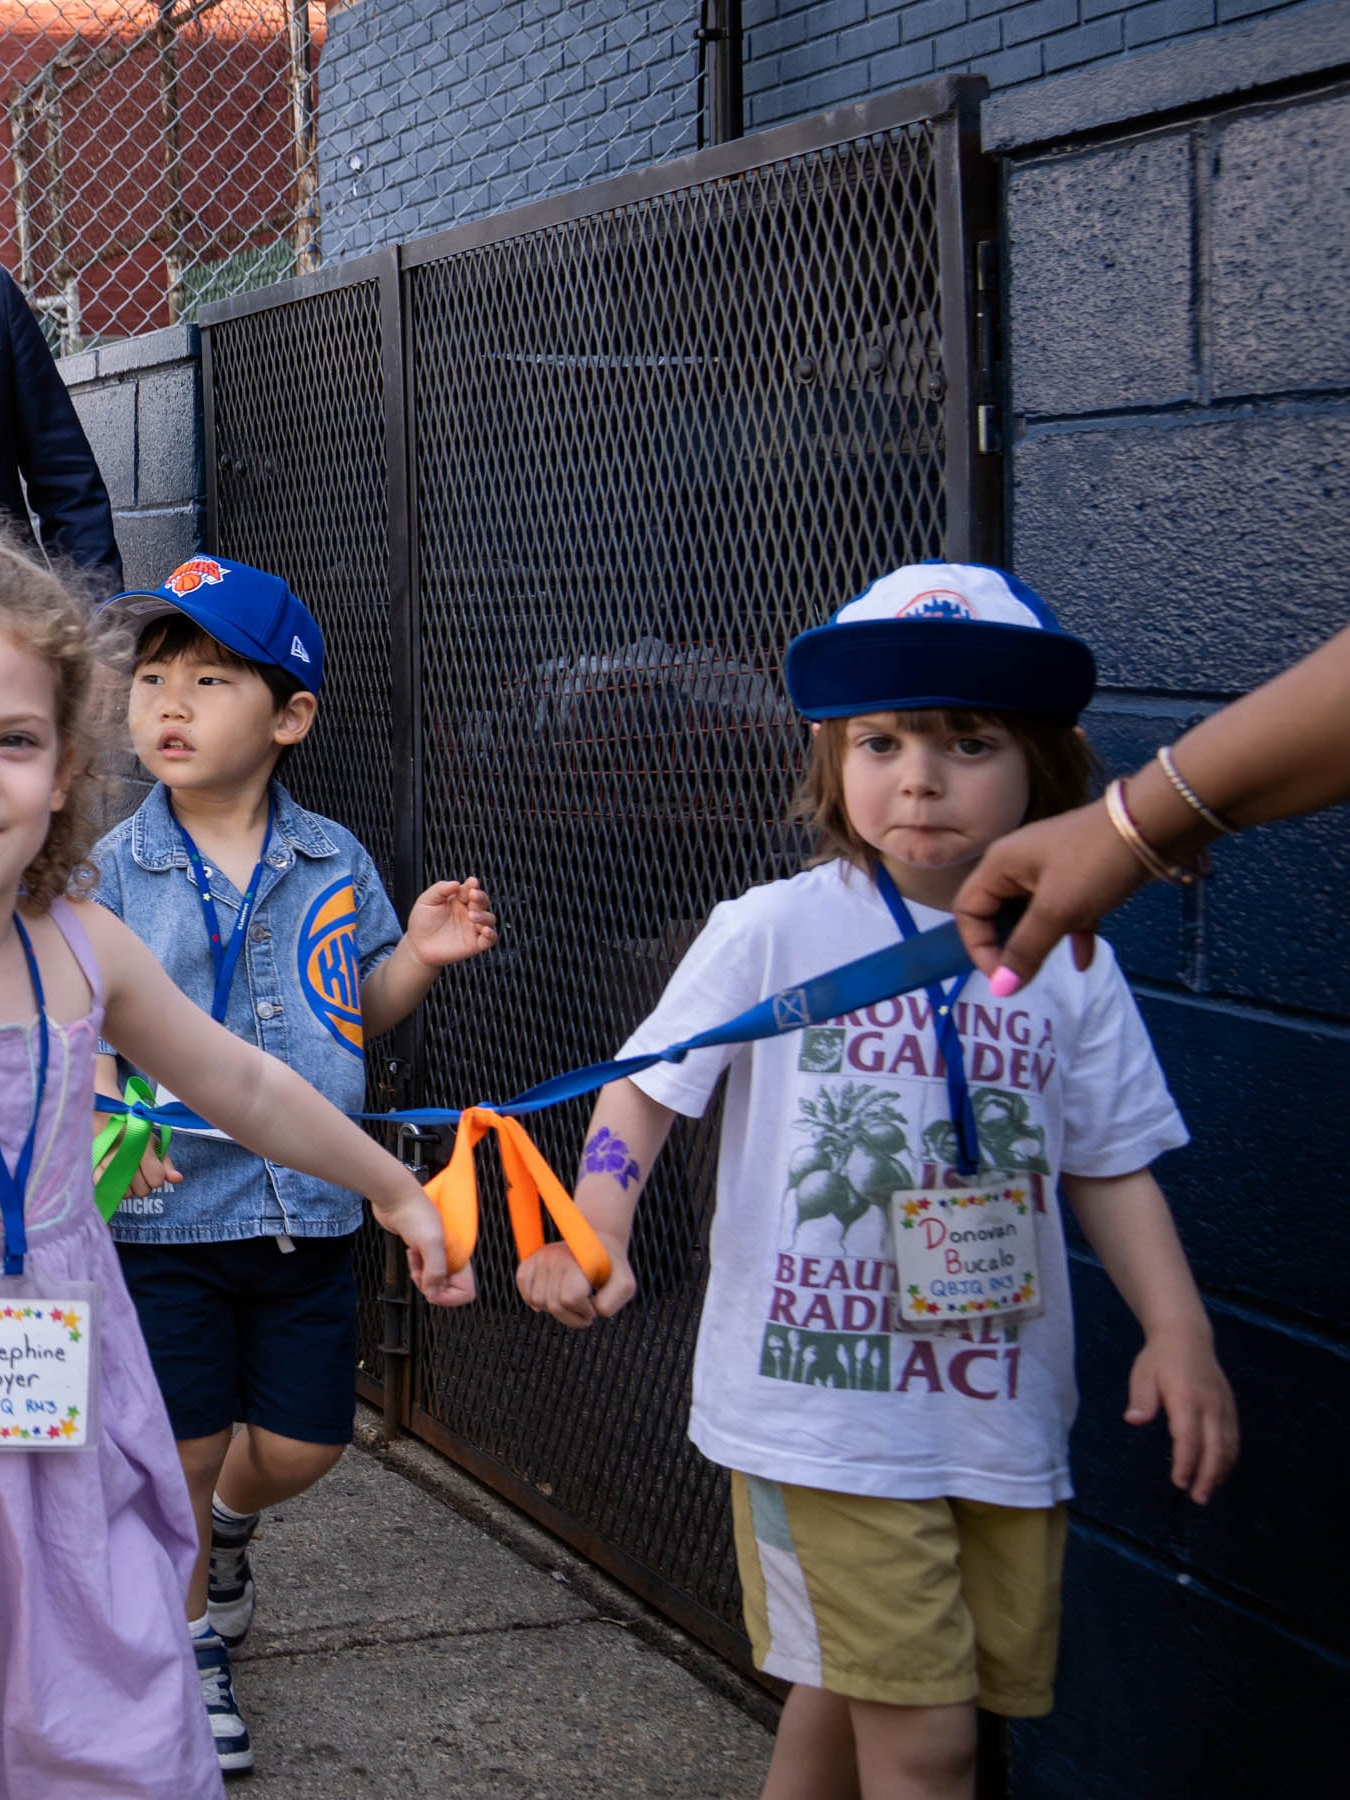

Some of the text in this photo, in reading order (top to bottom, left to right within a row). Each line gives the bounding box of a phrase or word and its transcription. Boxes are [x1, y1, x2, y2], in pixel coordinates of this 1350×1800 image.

[918, 1217, 1017, 1249] Donovan
[945, 1248, 1014, 1274] Bucalo
[930, 1279, 984, 1296] QBJQ
